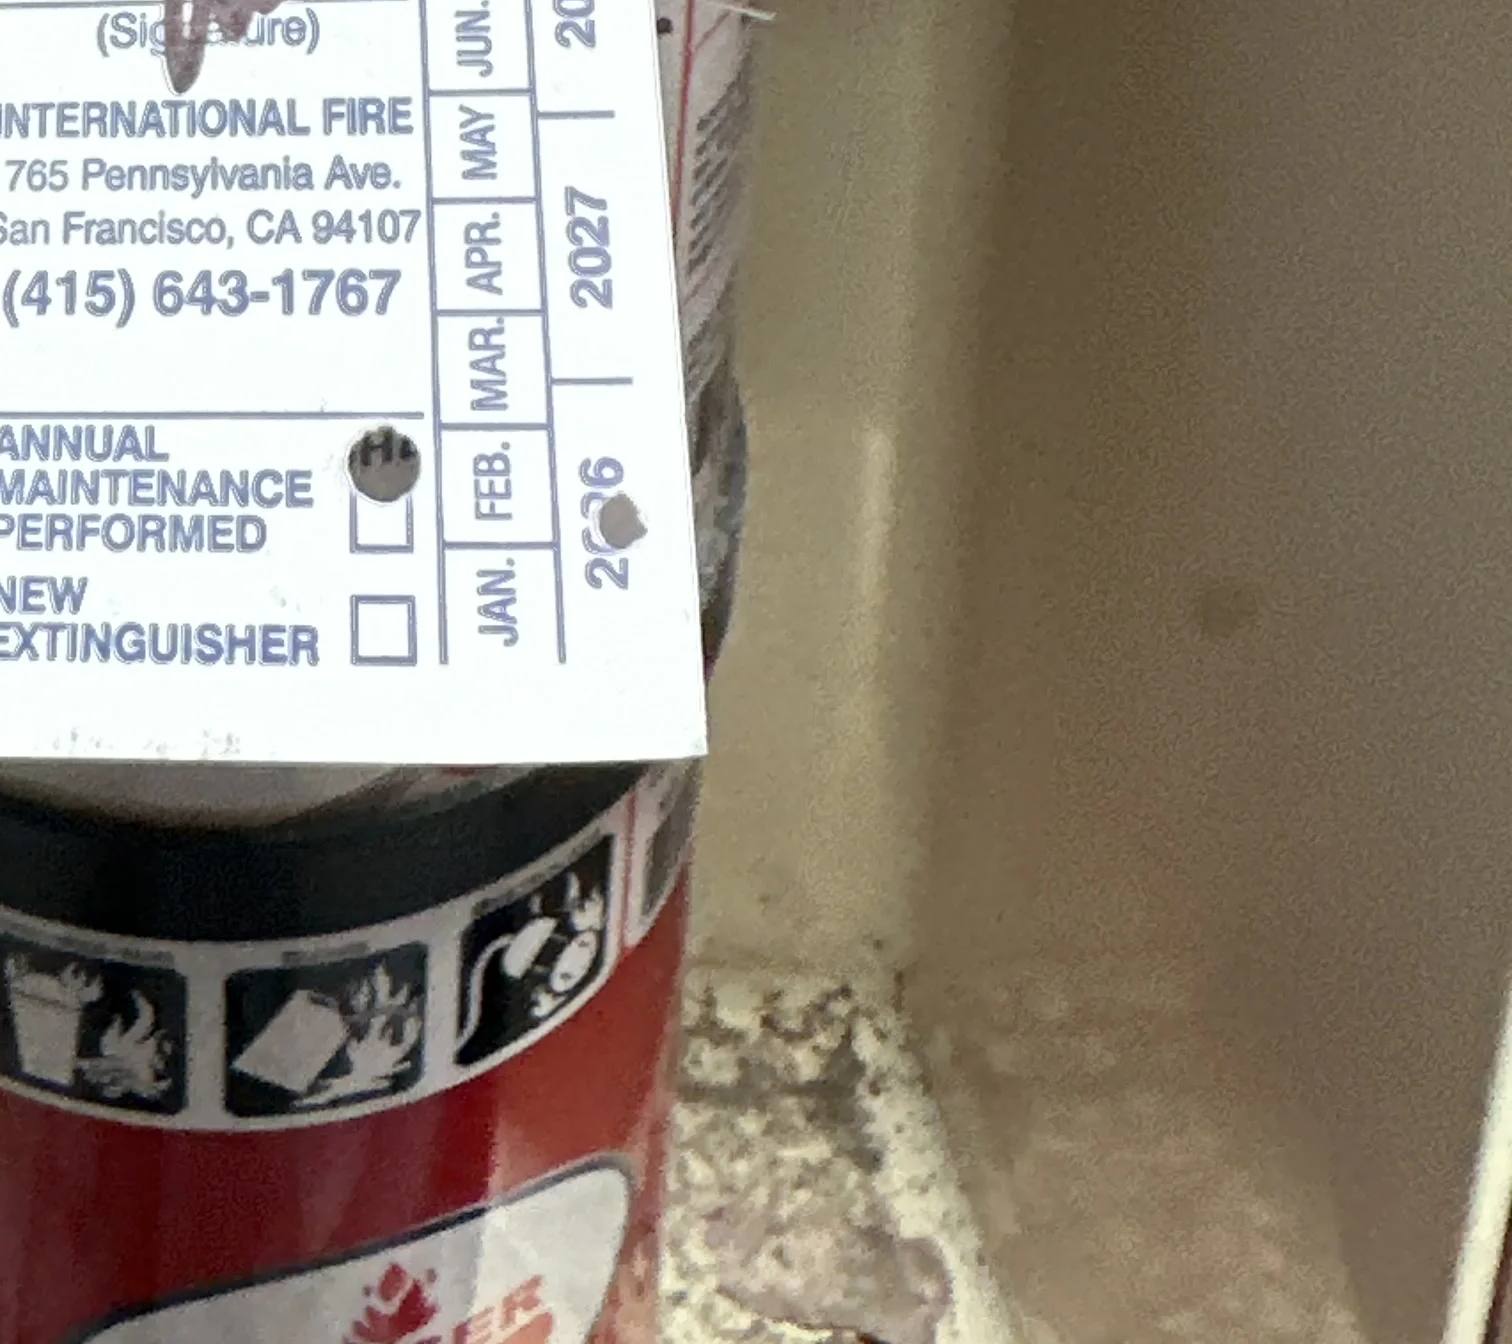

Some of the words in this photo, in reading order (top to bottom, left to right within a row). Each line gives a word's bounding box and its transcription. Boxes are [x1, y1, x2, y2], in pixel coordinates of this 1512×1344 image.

[97, 7, 320, 58] (Sigure)
[454, 0, 493, 77] JUN.
[322, 96, 414, 136] FIRE
[459, 104, 498, 181] MAY
[5, 159, 69, 192] 765
[81, 155, 314, 199] Pennsylvania
[324, 154, 402, 190] Ave.
[63, 210, 235, 249] Francisco,
[246, 209, 303, 244] CA
[311, 209, 422, 244] 94107
[464, 212, 503, 296] APR.
[565, 186, 613, 310] 2027
[2, 269, 136, 329] (415)
[152, 268, 402, 317] 643-1767
[468, 316, 508, 411] MAR.
[472, 441, 513, 521] FEB.
[476, 557, 519, 647] JAN.
